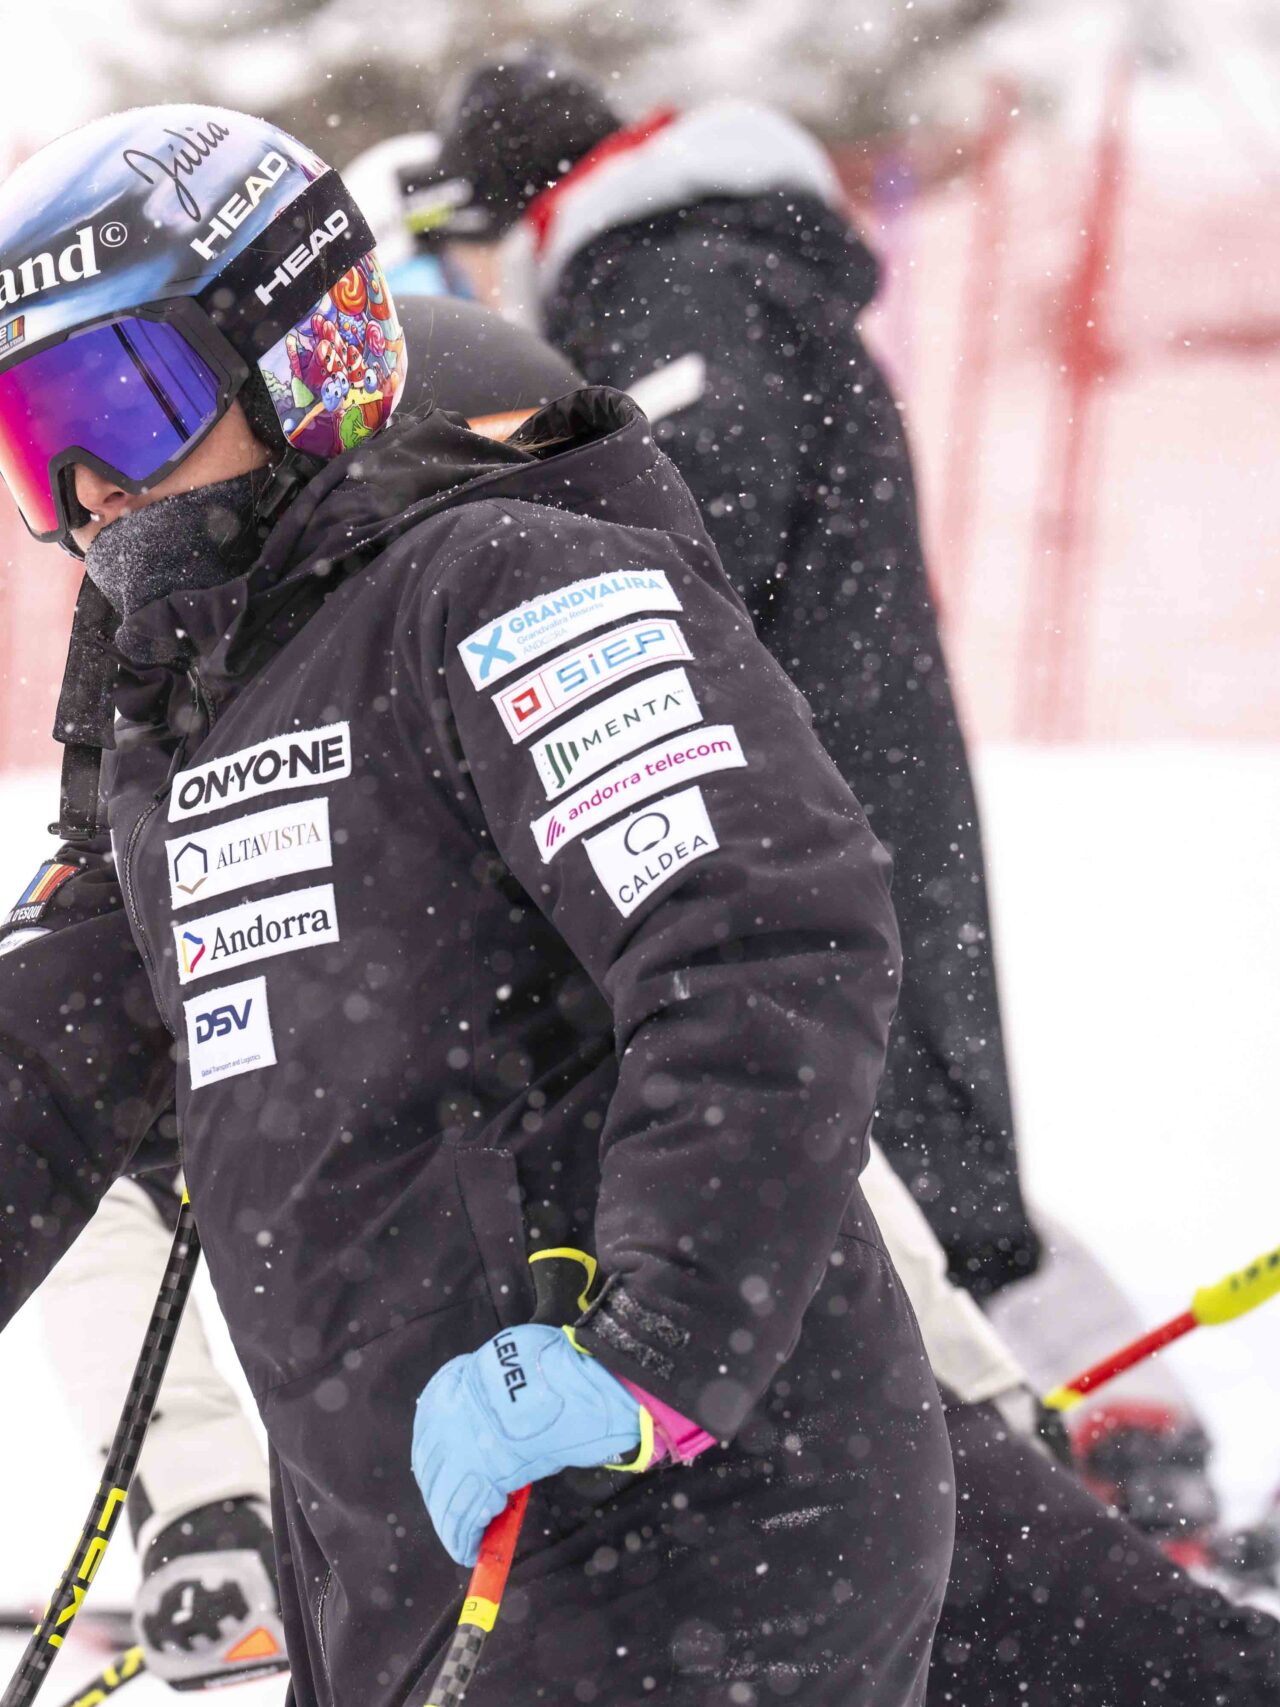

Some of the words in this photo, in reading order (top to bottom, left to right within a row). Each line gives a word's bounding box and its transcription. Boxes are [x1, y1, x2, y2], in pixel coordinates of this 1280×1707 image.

[190, 150, 289, 261] HEAD
[255, 209, 350, 306] HEAD
[508, 576, 663, 633] GRANDVALIRA
[581, 694, 681, 751] MENTA
[568, 773, 642, 821] andorra
[644, 740, 732, 776] telecom
[216, 821, 323, 870] ALTAVISTA
[618, 835, 709, 904] CALDEA
[210, 908, 332, 960] Andorra
[195, 998, 253, 1044] DSV
[493, 1331, 528, 1402] LEVEL
